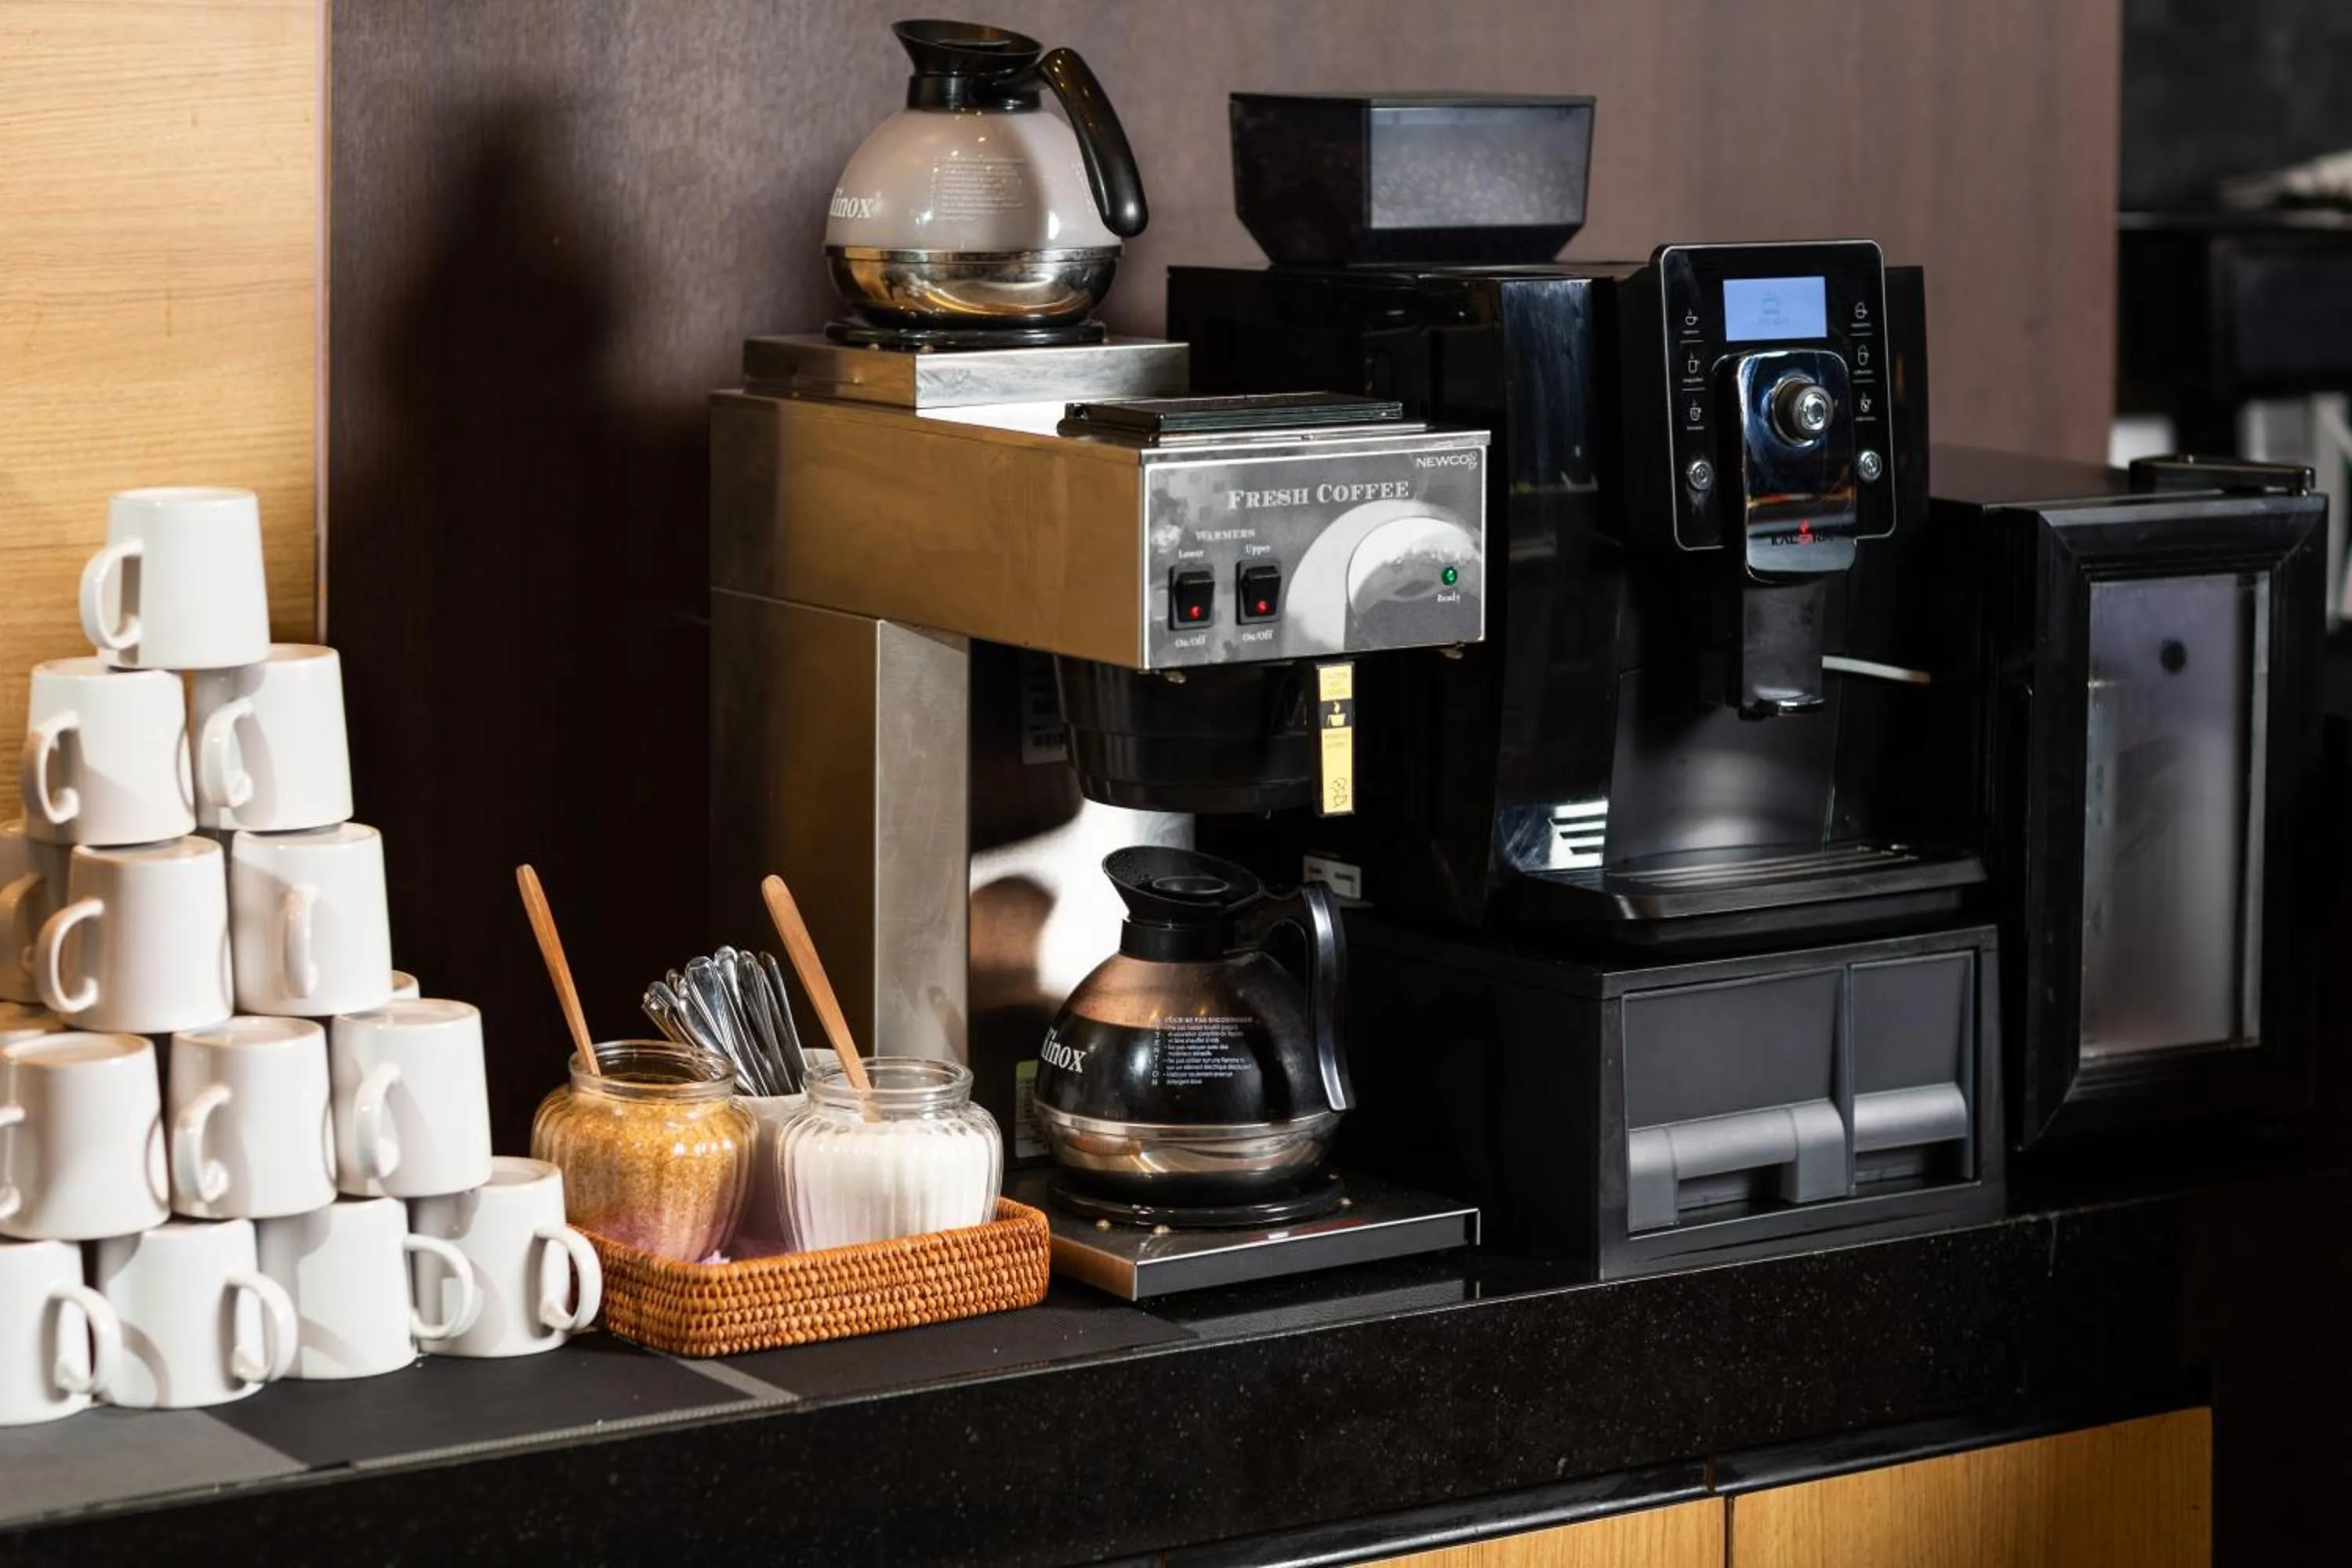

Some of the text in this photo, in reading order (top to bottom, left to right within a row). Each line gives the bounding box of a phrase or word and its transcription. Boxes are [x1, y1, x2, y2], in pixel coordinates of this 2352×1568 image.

[1416, 455, 1468, 468] NEWCO
[1228, 481, 1410, 510] FRESH COFFEE
[1196, 528, 1255, 542] WARMERS
[1178, 550, 1204, 559] Lower
[1245, 544, 1270, 556] Upper
